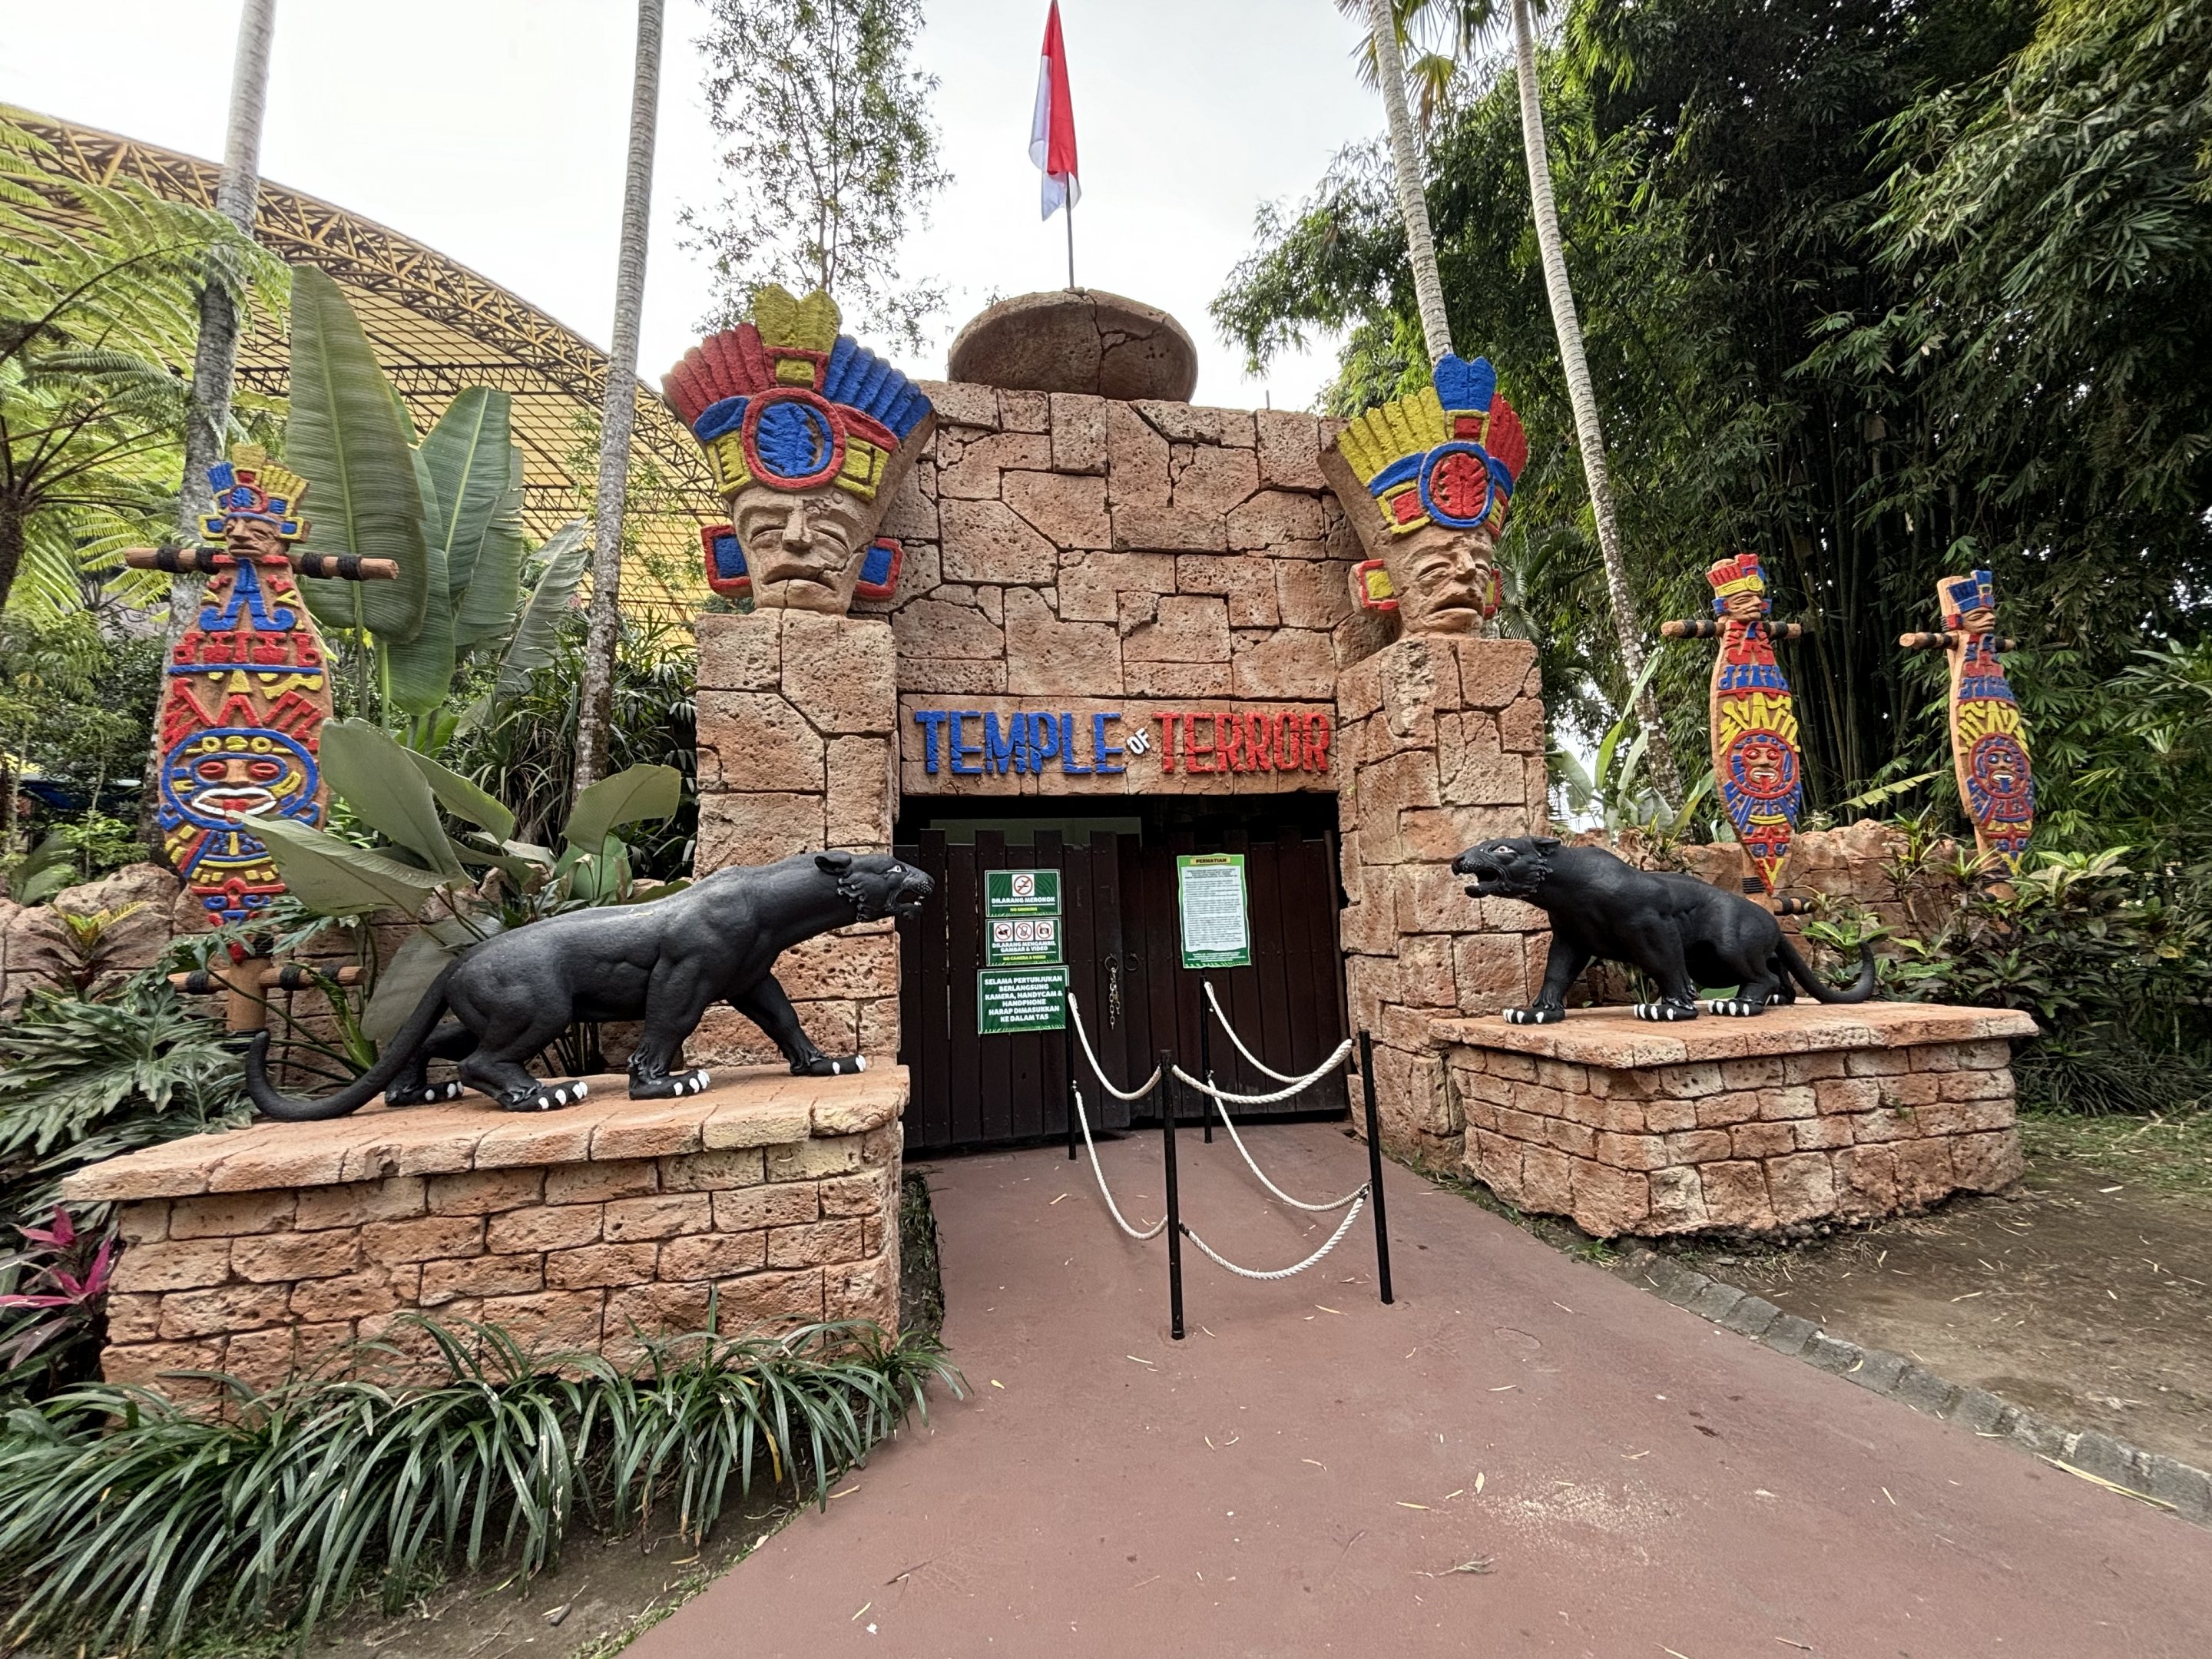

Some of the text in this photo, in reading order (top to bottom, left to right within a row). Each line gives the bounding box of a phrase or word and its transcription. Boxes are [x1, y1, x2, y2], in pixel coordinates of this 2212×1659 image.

[915, 710, 1329, 774] TEMPLE OF TERROR
